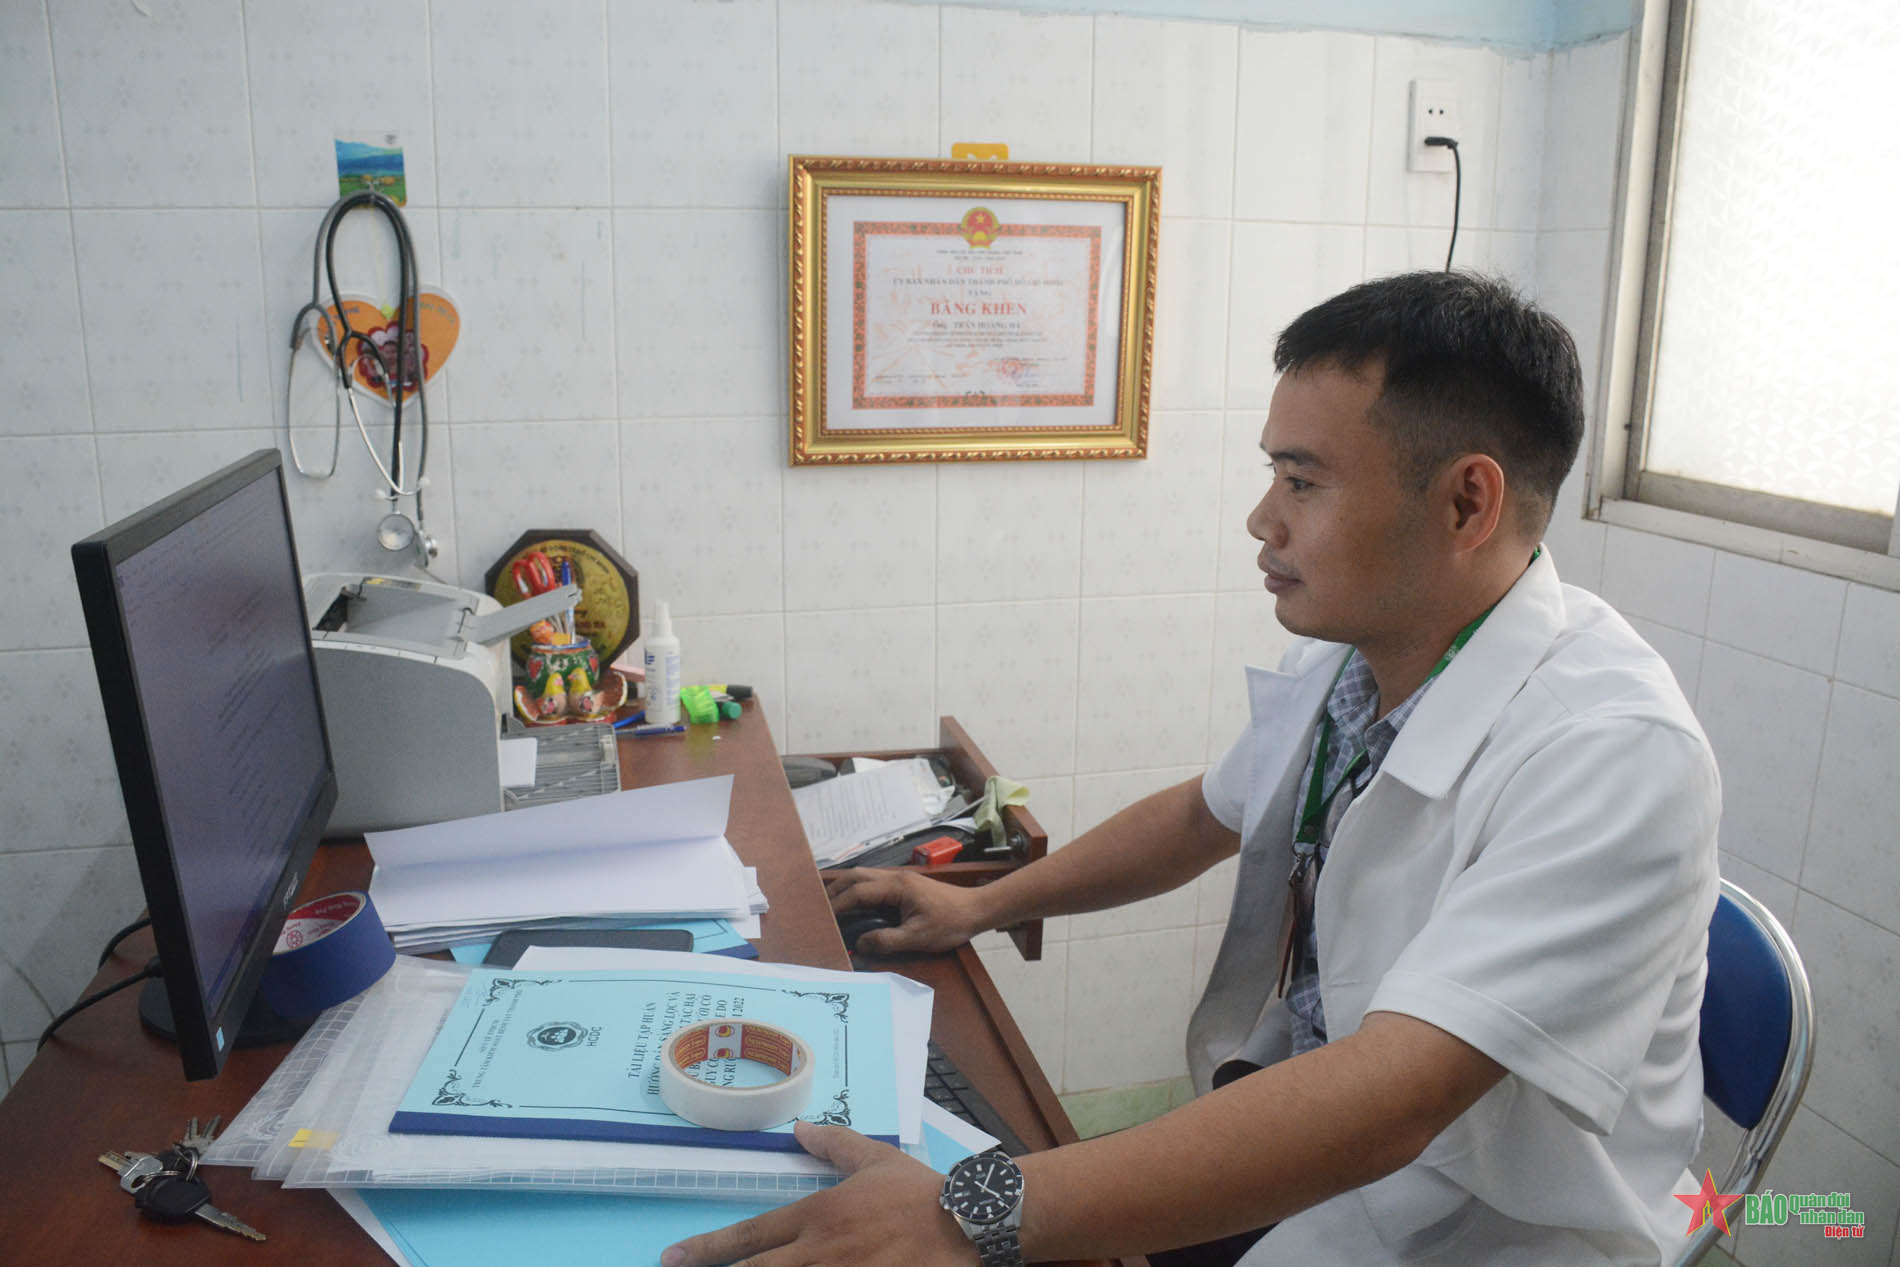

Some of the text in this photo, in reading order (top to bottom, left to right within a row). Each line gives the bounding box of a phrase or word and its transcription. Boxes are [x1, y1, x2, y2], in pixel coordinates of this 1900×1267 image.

[981, 303, 1027, 315] KHEN
[732, 997, 745, 1012] 2022
[586, 1026, 602, 1047] HCDC
[638, 1023, 653, 1041] TẬP
[632, 1042, 648, 1063] LIỆU
